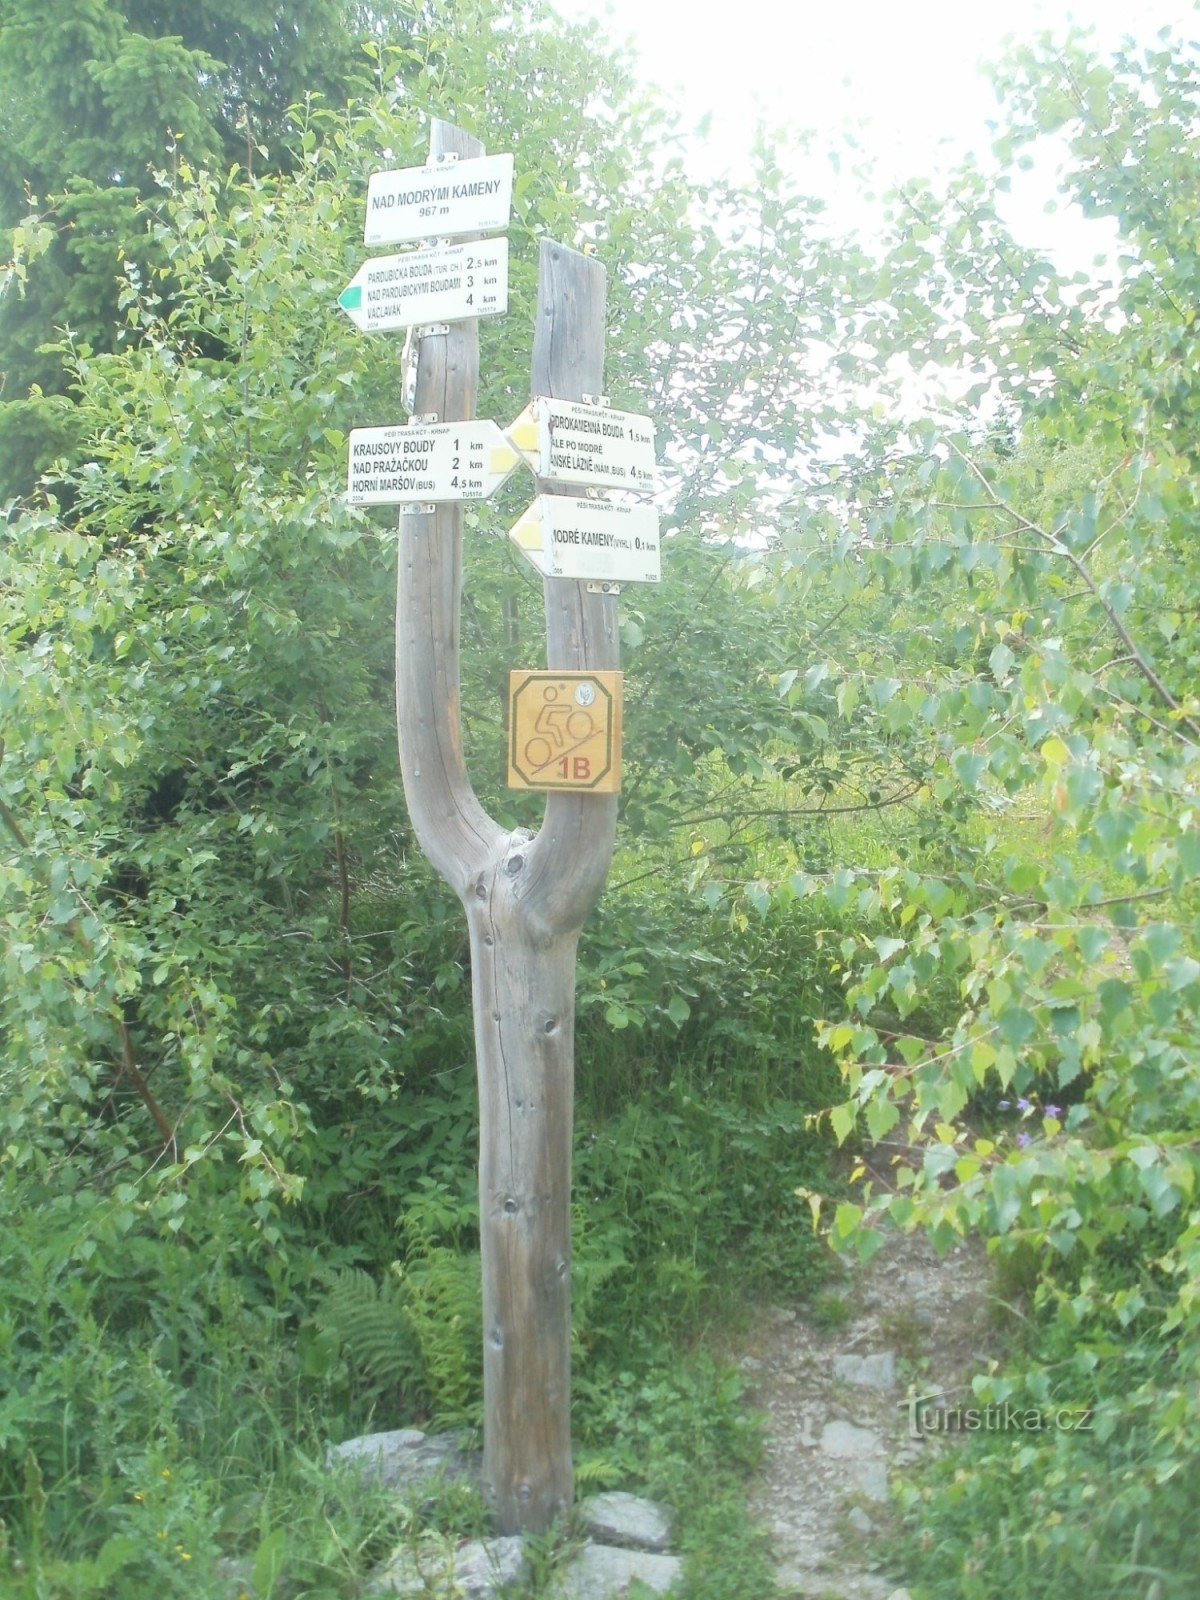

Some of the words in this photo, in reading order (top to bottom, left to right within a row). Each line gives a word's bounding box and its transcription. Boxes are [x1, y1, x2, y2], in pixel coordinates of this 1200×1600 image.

[372, 194, 395, 210] NAD
[397, 185, 449, 207] MODRÝMI
[452, 179, 501, 199] KAMENY
[419, 206, 437, 217] 967
[440, 206, 449, 214] m
[409, 264, 433, 278] BOUDA
[484, 258, 498, 267] km
[367, 289, 380, 302] NAD
[430, 277, 461, 293] BOUDAMI
[467, 276, 474, 288] 3
[483, 277, 497, 286] km
[466, 294, 474, 306] 4
[483, 295, 496, 304] km
[603, 422, 624, 439] BOUDA
[641, 435, 651, 444] km
[353, 442, 401, 456] KRAUSOVY
[403, 439, 436, 454] BOUDY
[454, 438, 459, 450] 1
[470, 442, 483, 450] km
[566, 440, 577, 450] PO
[578, 442, 603, 454] MODRÉ
[353, 462, 371, 474] NAD
[373, 457, 428, 473] PRAŽAČKOU
[452, 457, 460, 469] 2
[469, 460, 483, 469] km
[353, 476, 378, 492] HORNÍ
[379, 475, 416, 491] MARŠOV
[416, 480, 436, 491] (BUS)
[451, 476, 467, 489] 4,5
[469, 479, 482, 488] km
[643, 471, 653, 480] km
[581, 531, 614, 548] KAMENY
[646, 541, 656, 550] km
[559, 756, 591, 779] 1B
